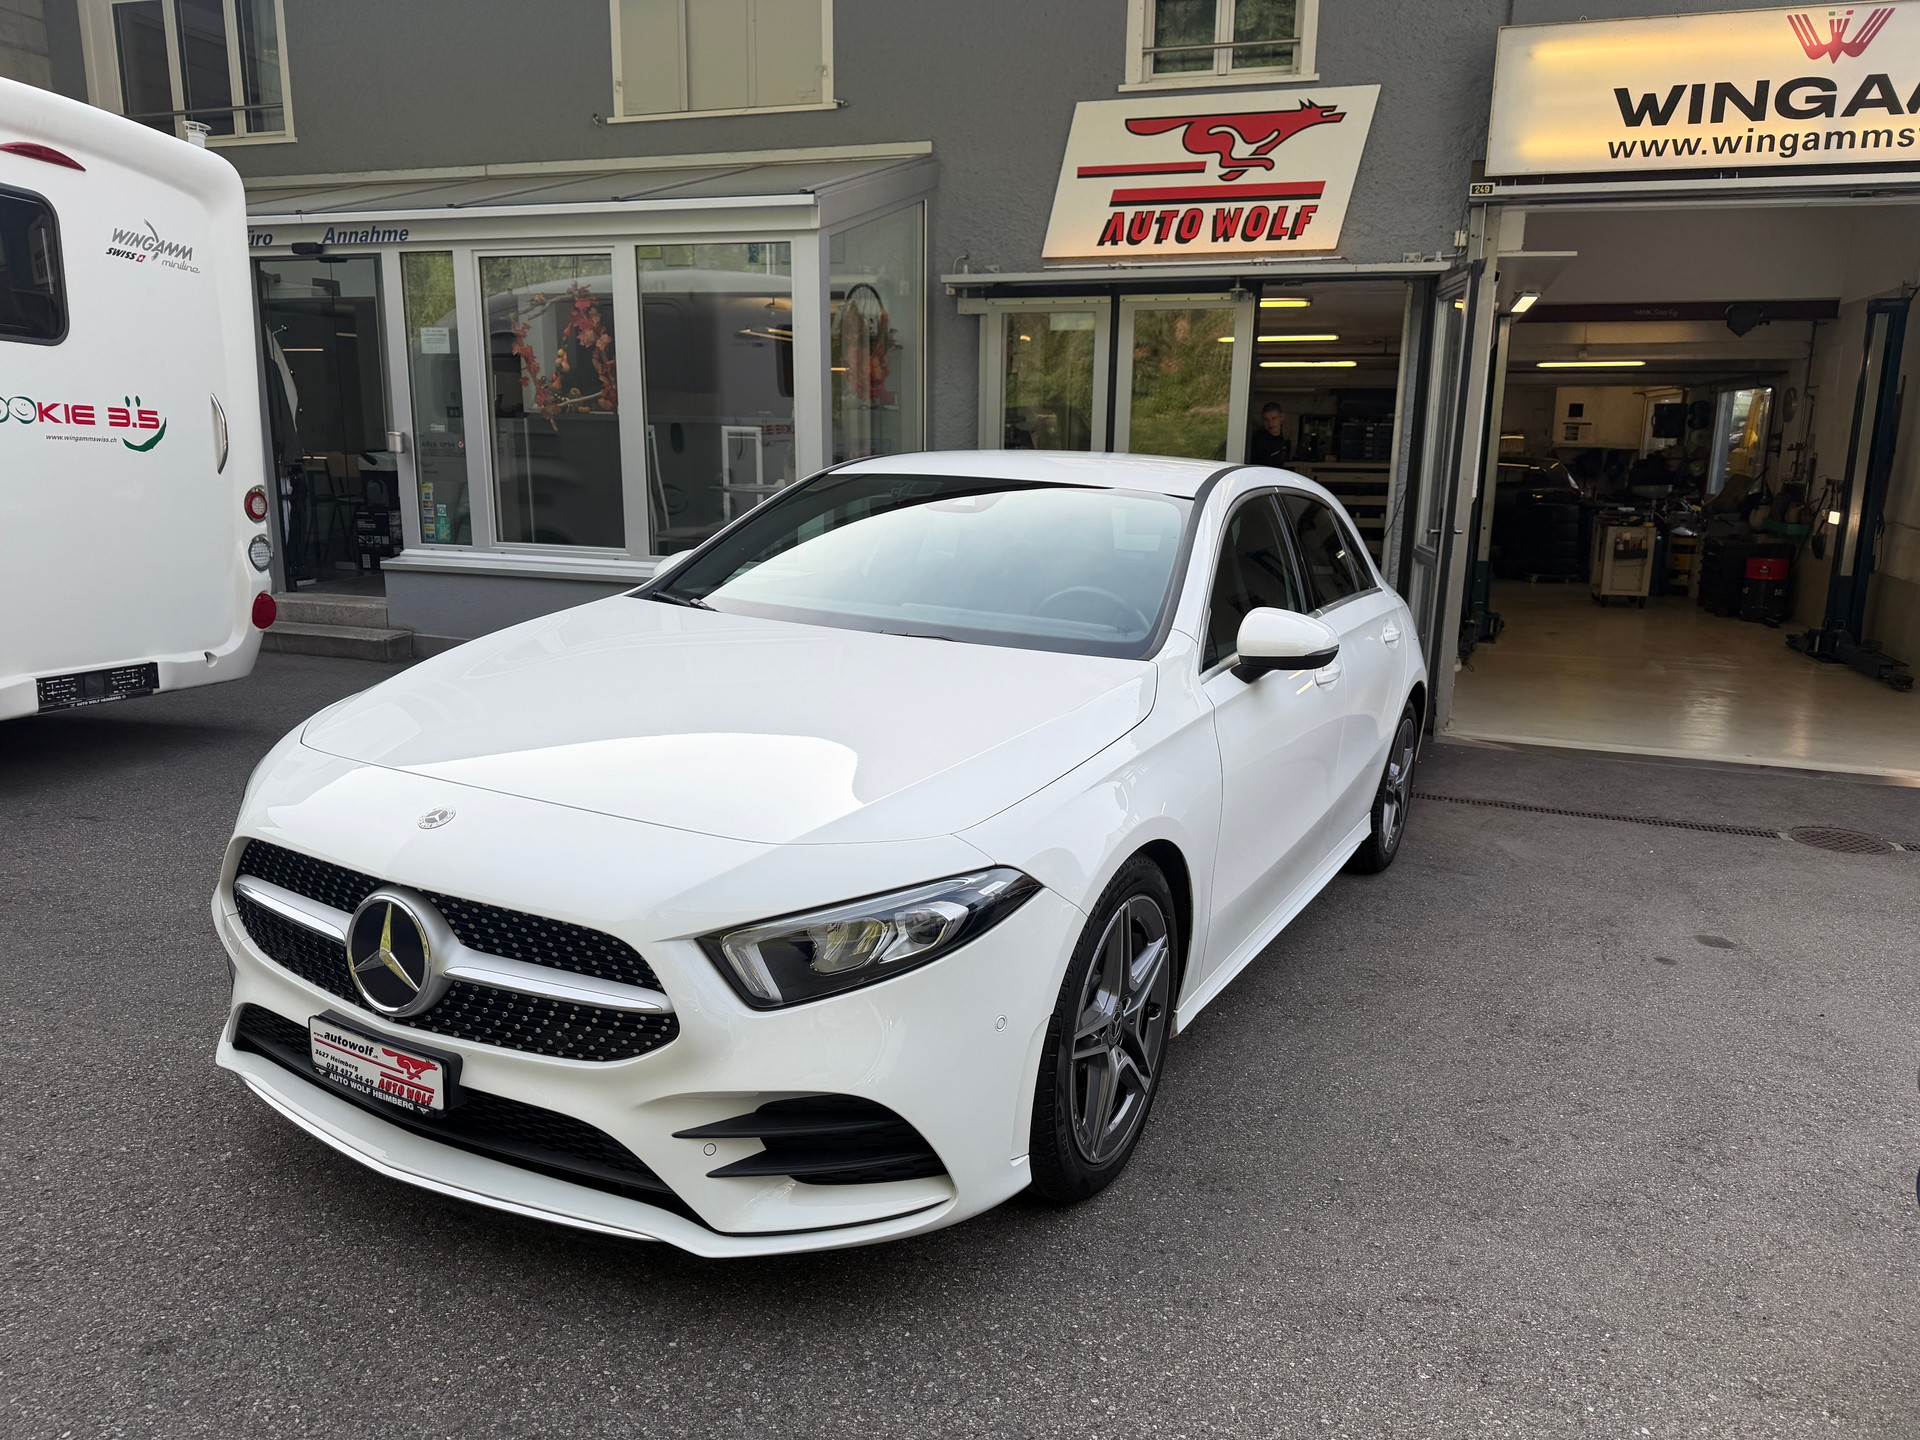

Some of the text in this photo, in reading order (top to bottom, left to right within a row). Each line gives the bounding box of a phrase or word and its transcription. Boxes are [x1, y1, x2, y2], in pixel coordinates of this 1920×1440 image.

[1613, 73, 1920, 128] WINGA
[1608, 127, 1920, 159] www.wingamms
[1474, 185, 1490, 194] 249
[322, 225, 409, 244] Annahme
[1097, 204, 1319, 247] AUTO WOLF
[111, 227, 193, 261] WINGAMM
[248, 230, 273, 246] üro
[106, 247, 137, 260] SWISS
[161, 259, 200, 274] miniline
[107, 406, 160, 430] 3.5
[46, 434, 118, 443] www.wingammswiss.ch
[315, 1048, 359, 1073] 3627 Heimberg
[326, 1062, 339, 1072] 033
[340, 1067, 353, 1078] 437
[354, 1072, 364, 1083] 44
[329, 1073, 414, 1111] AUTO WOLF HEIMBERG
[377, 1077, 434, 1107] AUTO WOLF
